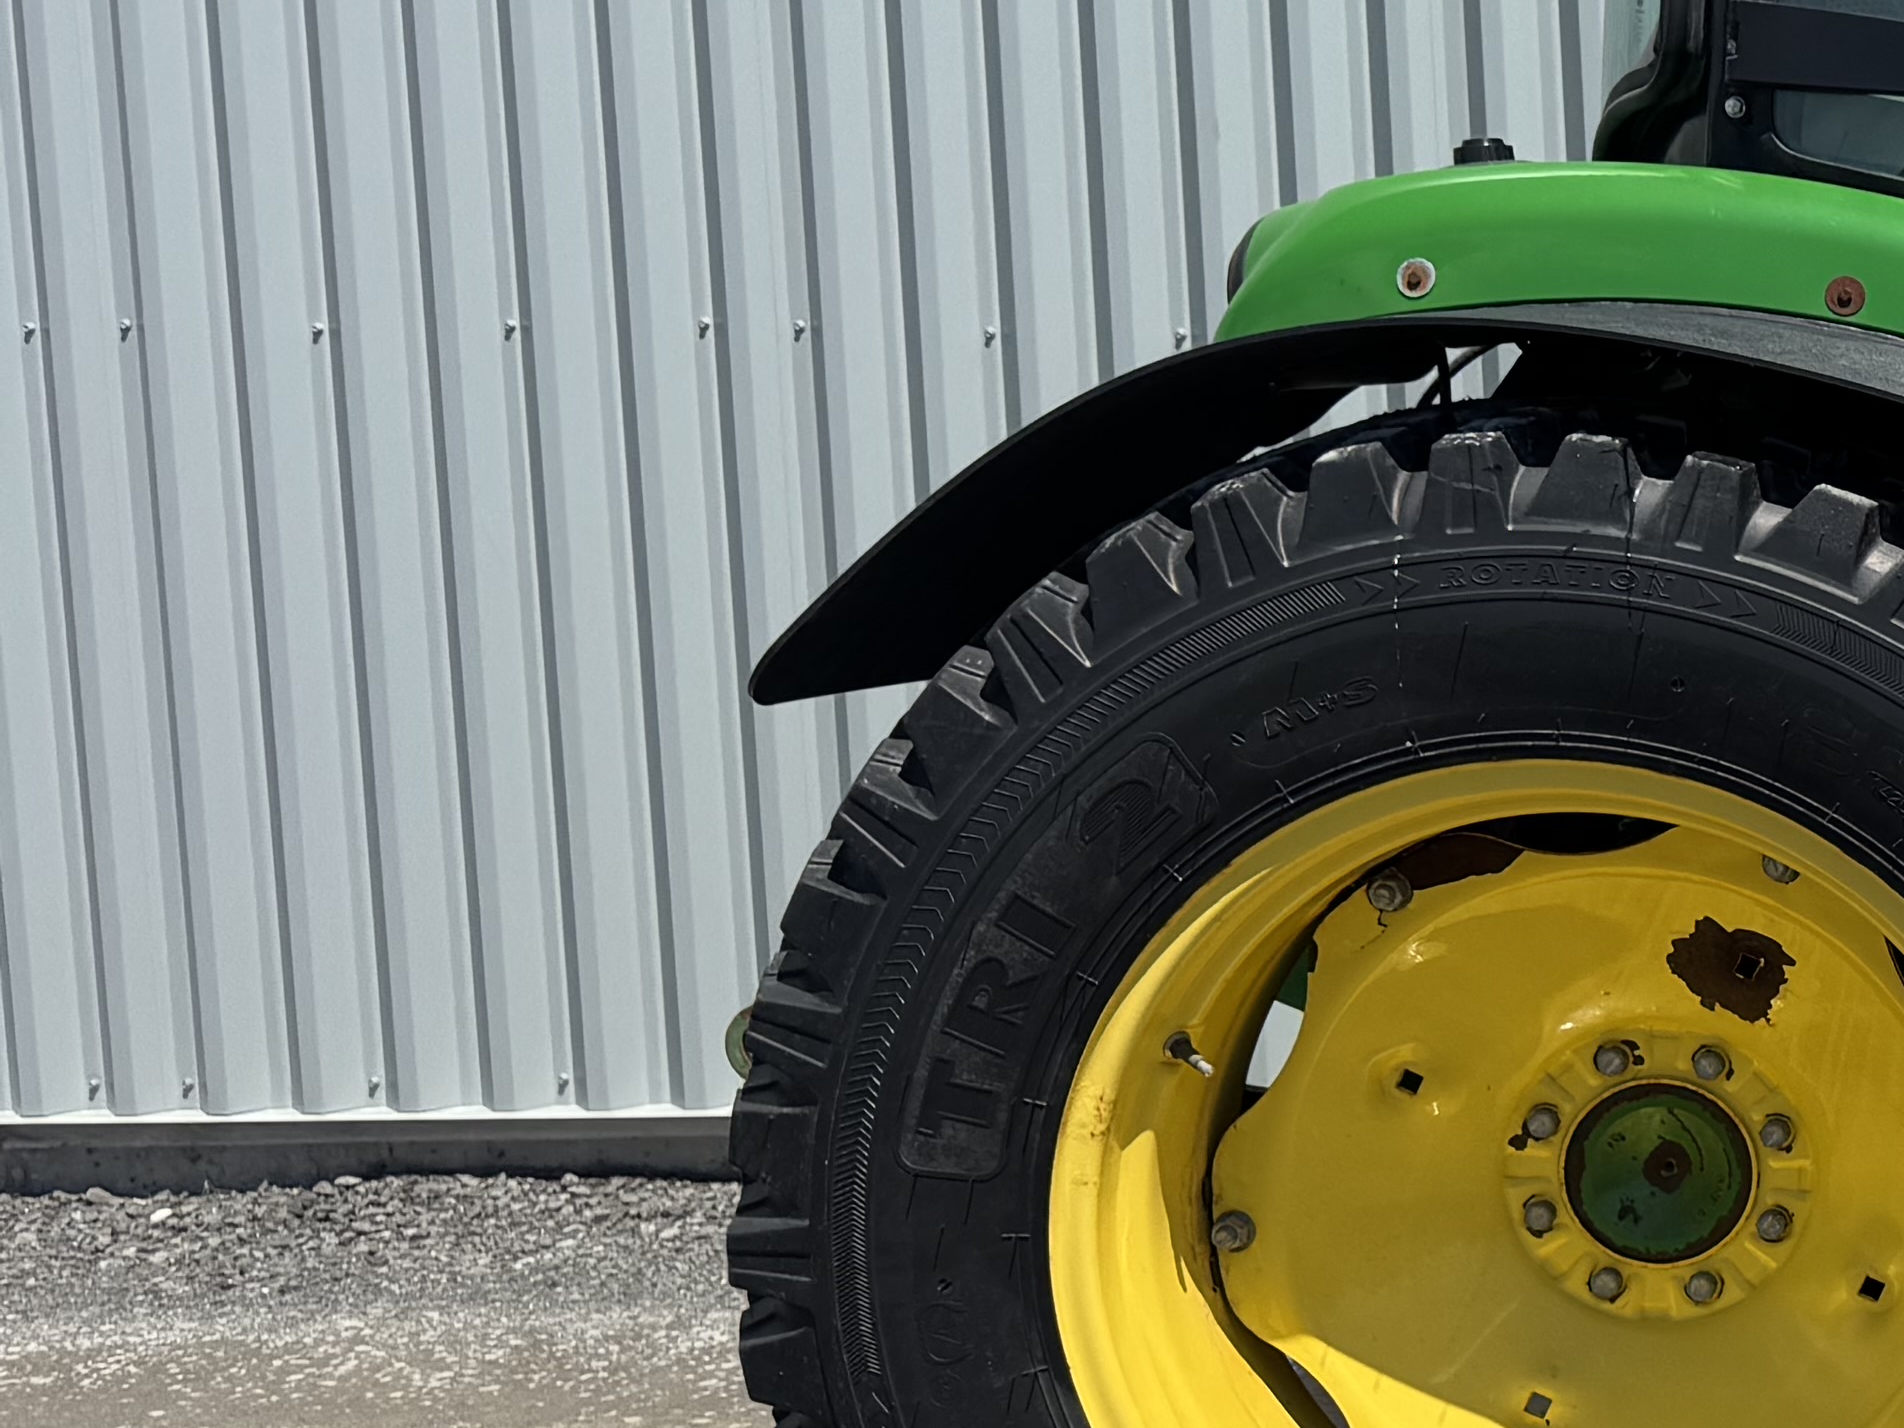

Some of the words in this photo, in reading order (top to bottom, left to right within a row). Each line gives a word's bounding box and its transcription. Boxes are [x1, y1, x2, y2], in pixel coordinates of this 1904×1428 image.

[1437, 560, 1677, 600] ROTATION
[914, 890, 1078, 1138] TRI
[1078, 777, 1184, 870] 2
